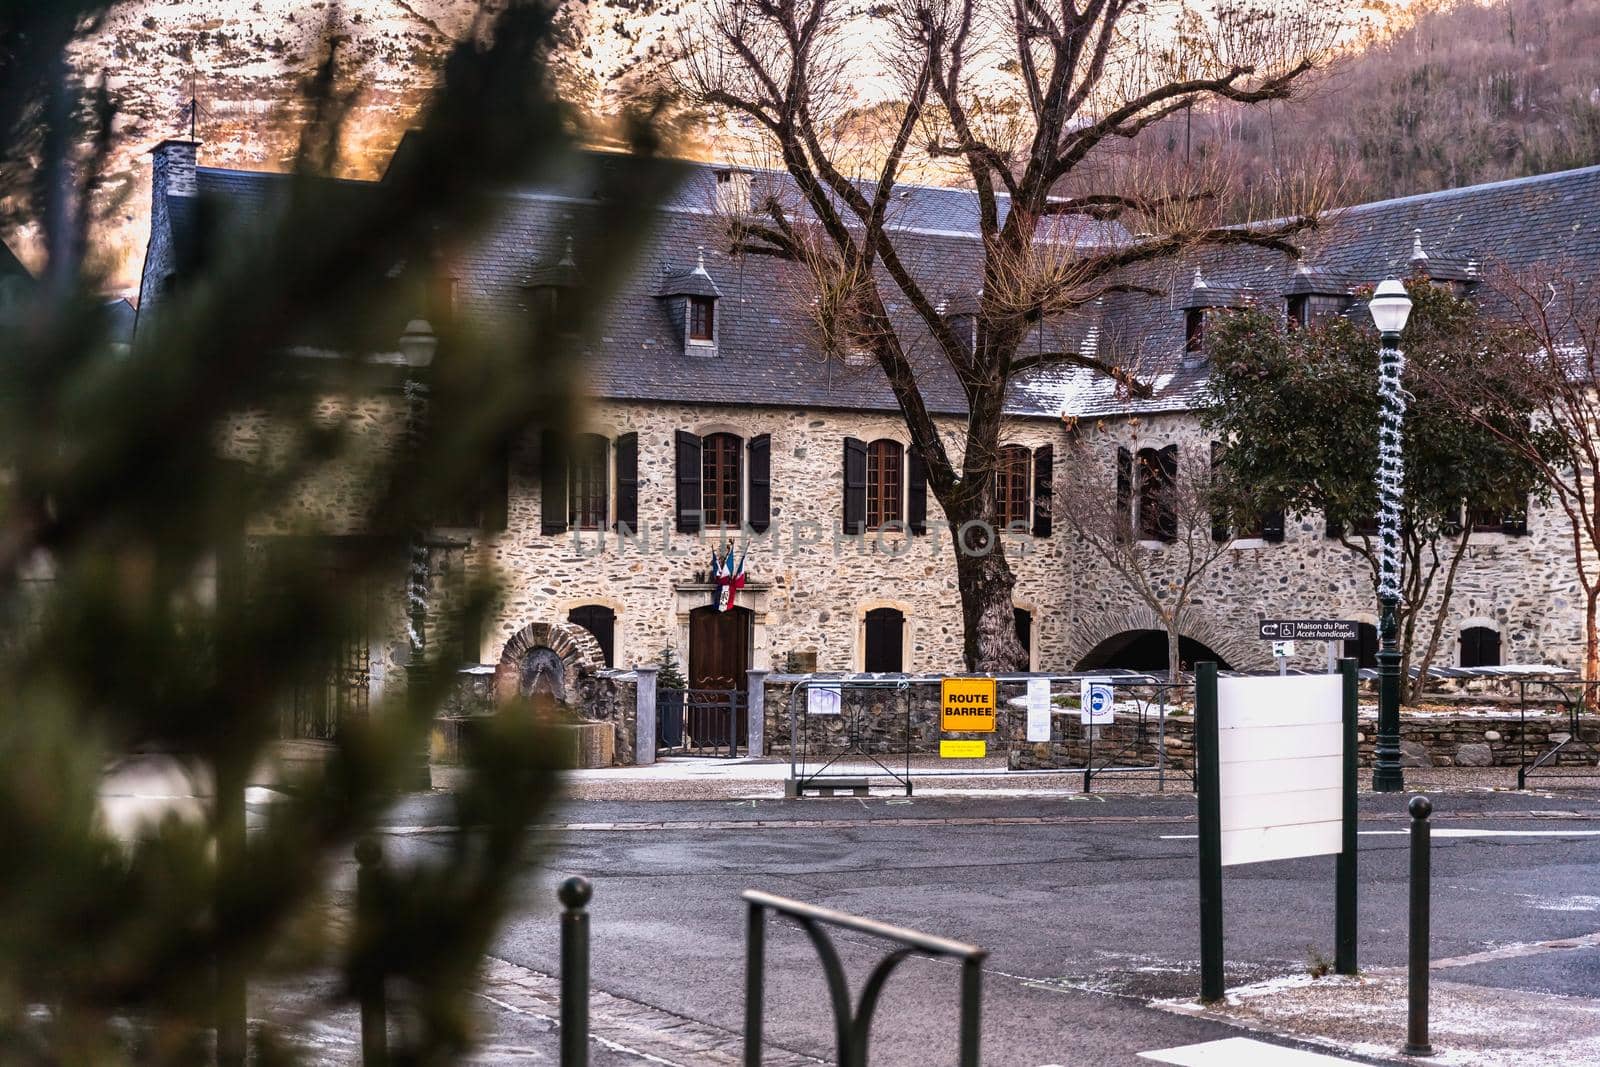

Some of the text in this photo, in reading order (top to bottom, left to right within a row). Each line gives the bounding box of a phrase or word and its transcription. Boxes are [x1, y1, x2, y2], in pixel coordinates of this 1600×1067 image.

[1297, 622, 1350, 630] Maison du Parc
[1297, 630, 1355, 639] Accès handicapés
[949, 694, 989, 703] ROUTE
[945, 707, 992, 716] BARREE
